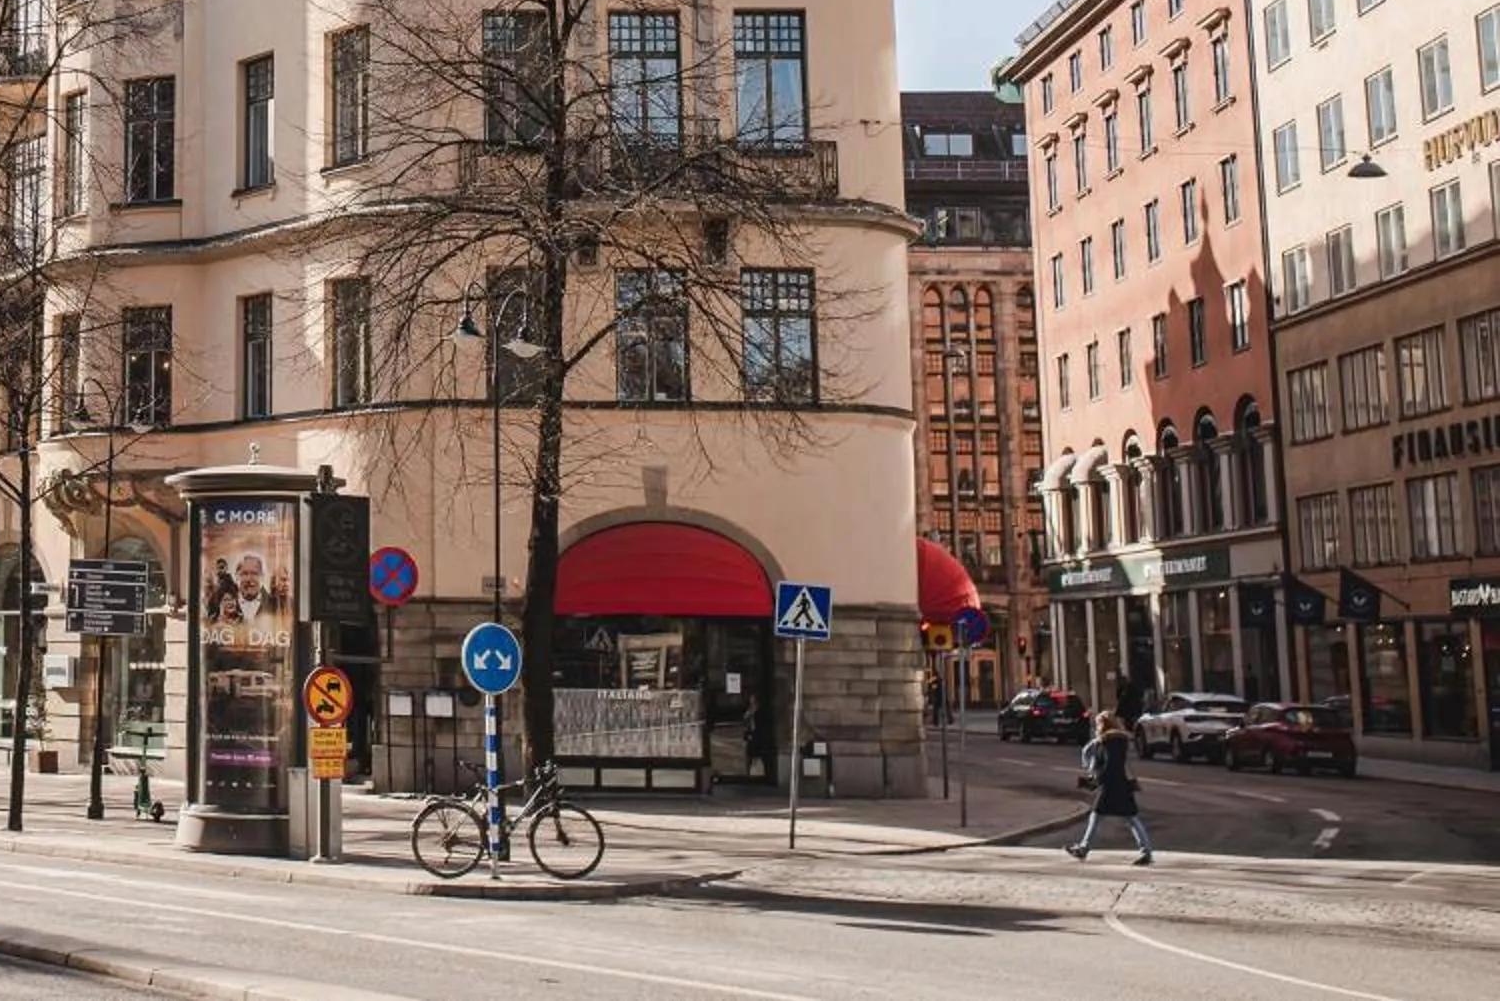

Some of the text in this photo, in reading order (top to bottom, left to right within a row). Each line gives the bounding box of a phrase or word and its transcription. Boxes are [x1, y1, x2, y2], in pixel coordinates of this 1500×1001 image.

[229, 510, 276, 524] MORE
[200, 627, 235, 646] DAG
[248, 629, 291, 648] DAG
